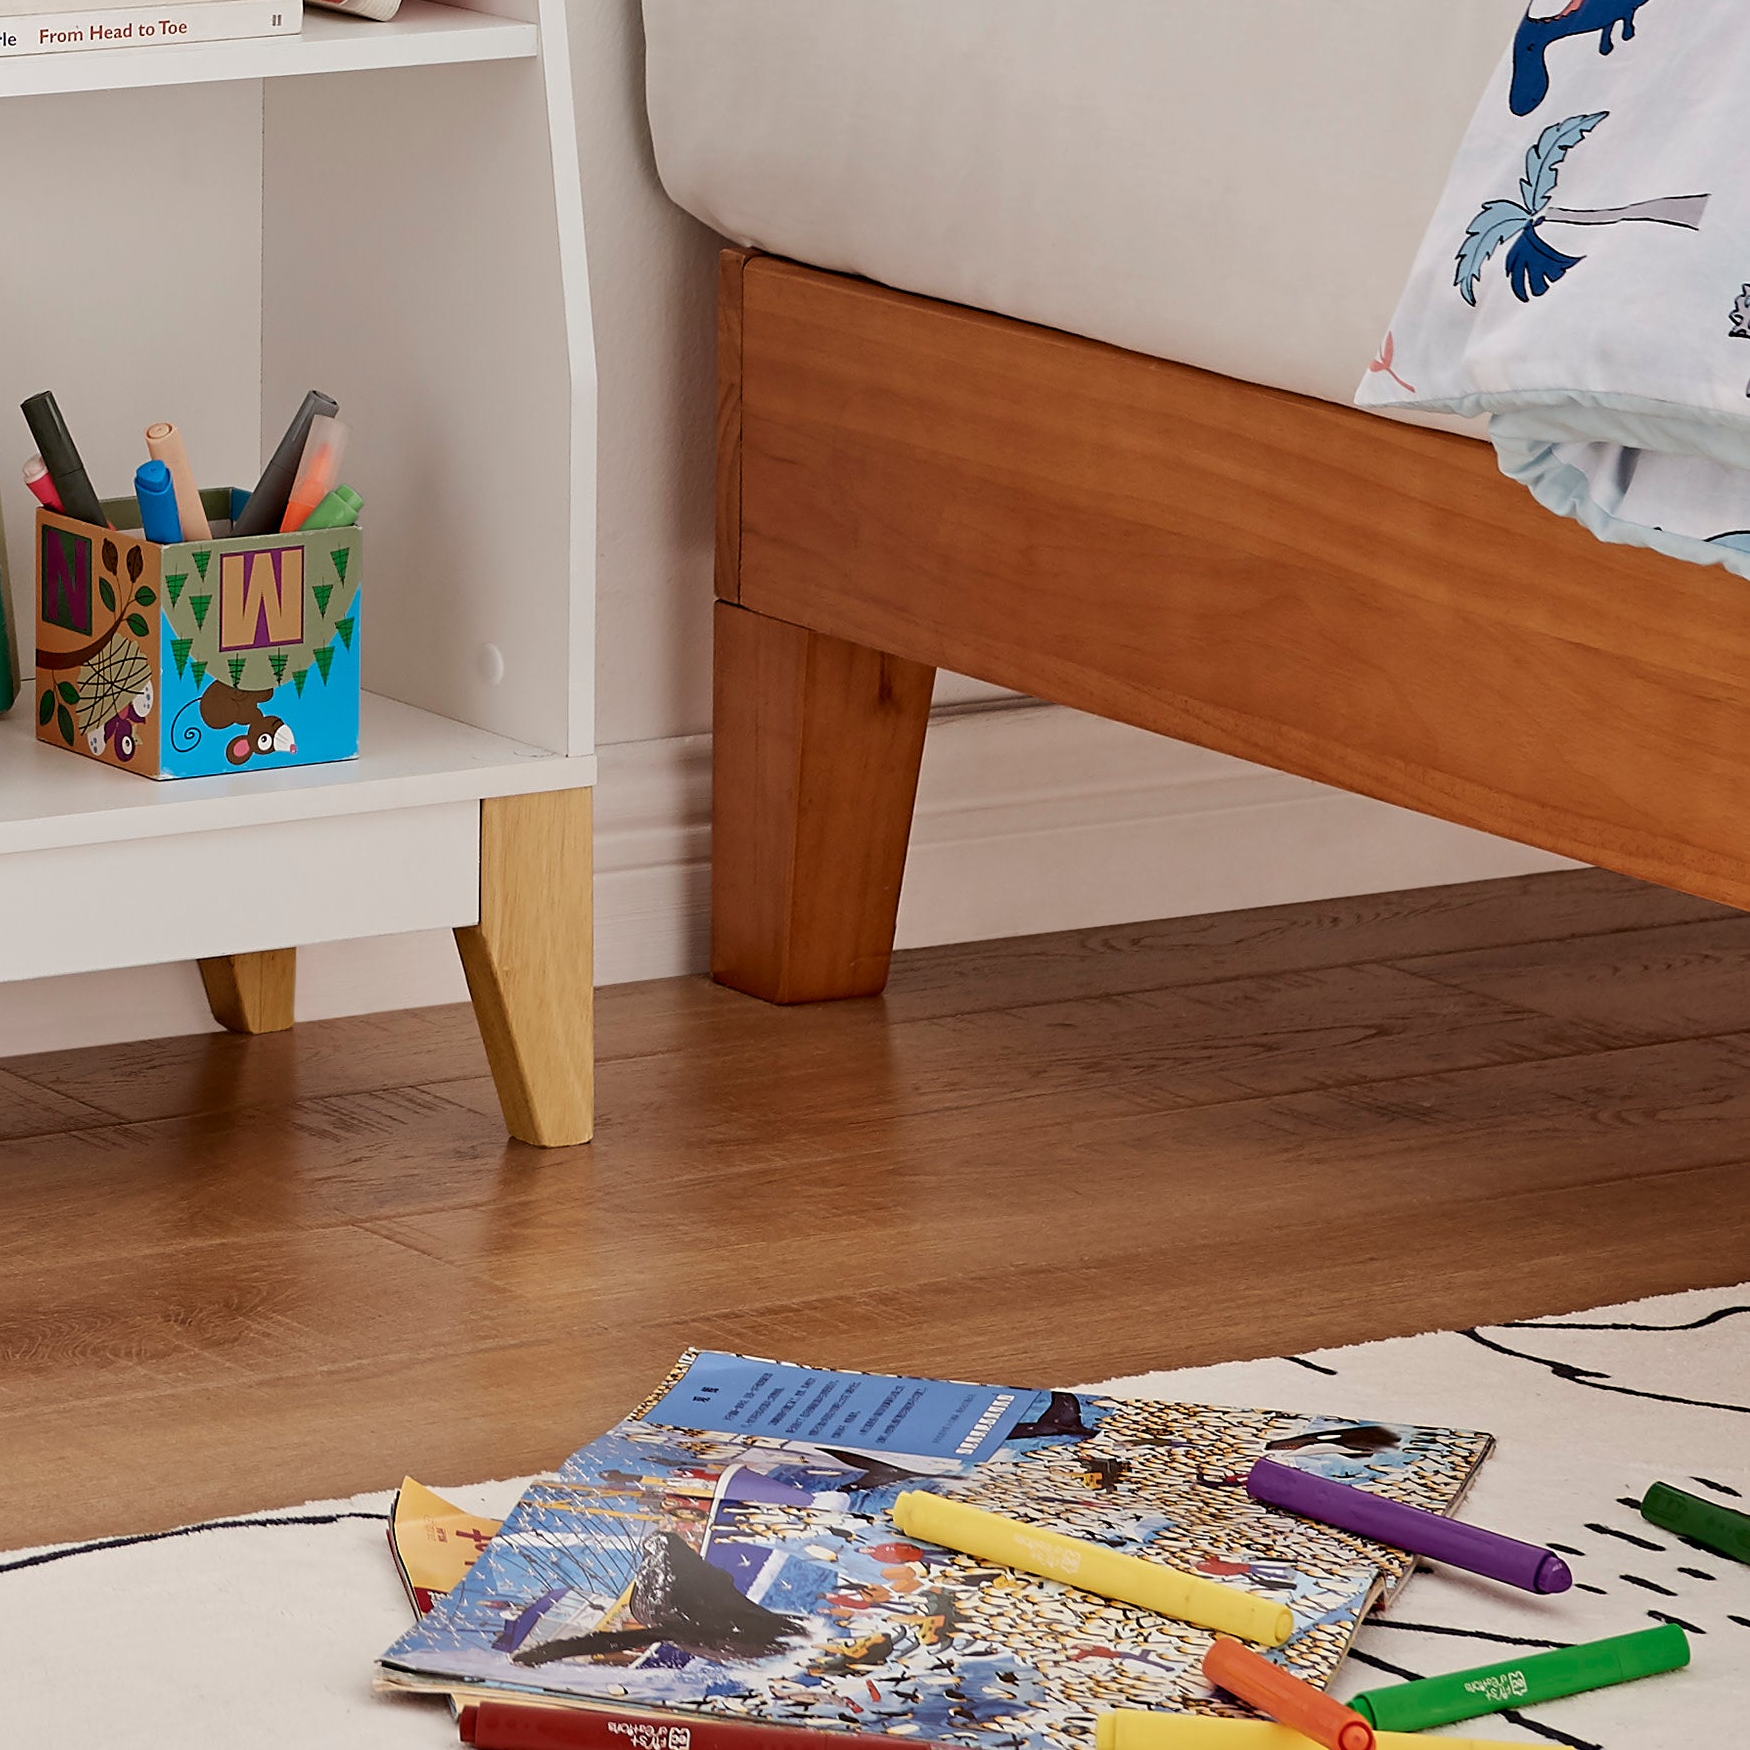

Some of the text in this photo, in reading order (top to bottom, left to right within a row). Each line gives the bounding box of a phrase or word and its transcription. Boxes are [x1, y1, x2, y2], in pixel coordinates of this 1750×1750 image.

[39, 27, 84, 45] From
[89, 23, 133, 41] Head
[138, 24, 155, 37] to
[158, 20, 188, 36] Toe
